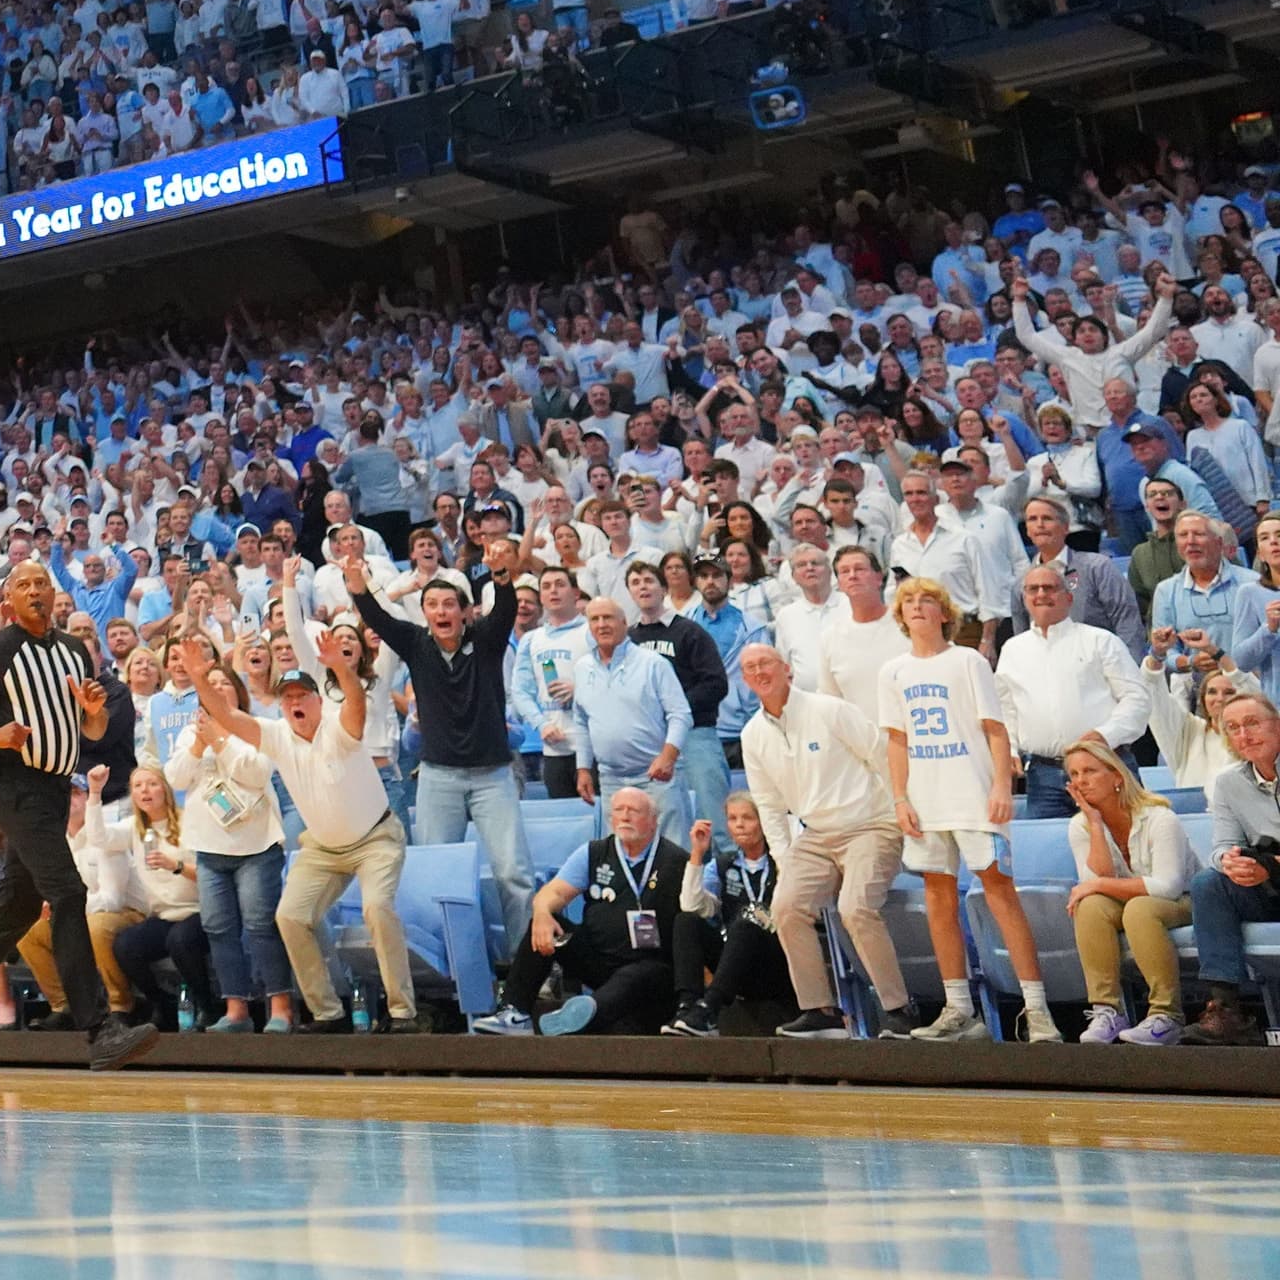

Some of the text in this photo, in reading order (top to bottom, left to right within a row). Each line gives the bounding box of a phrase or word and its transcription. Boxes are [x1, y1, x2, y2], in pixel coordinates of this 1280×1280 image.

[12, 203, 83, 242] Year
[91, 190, 137, 225] for
[143, 150, 309, 213] Education
[904, 683, 949, 703] NORTH
[911, 707, 949, 736] 23
